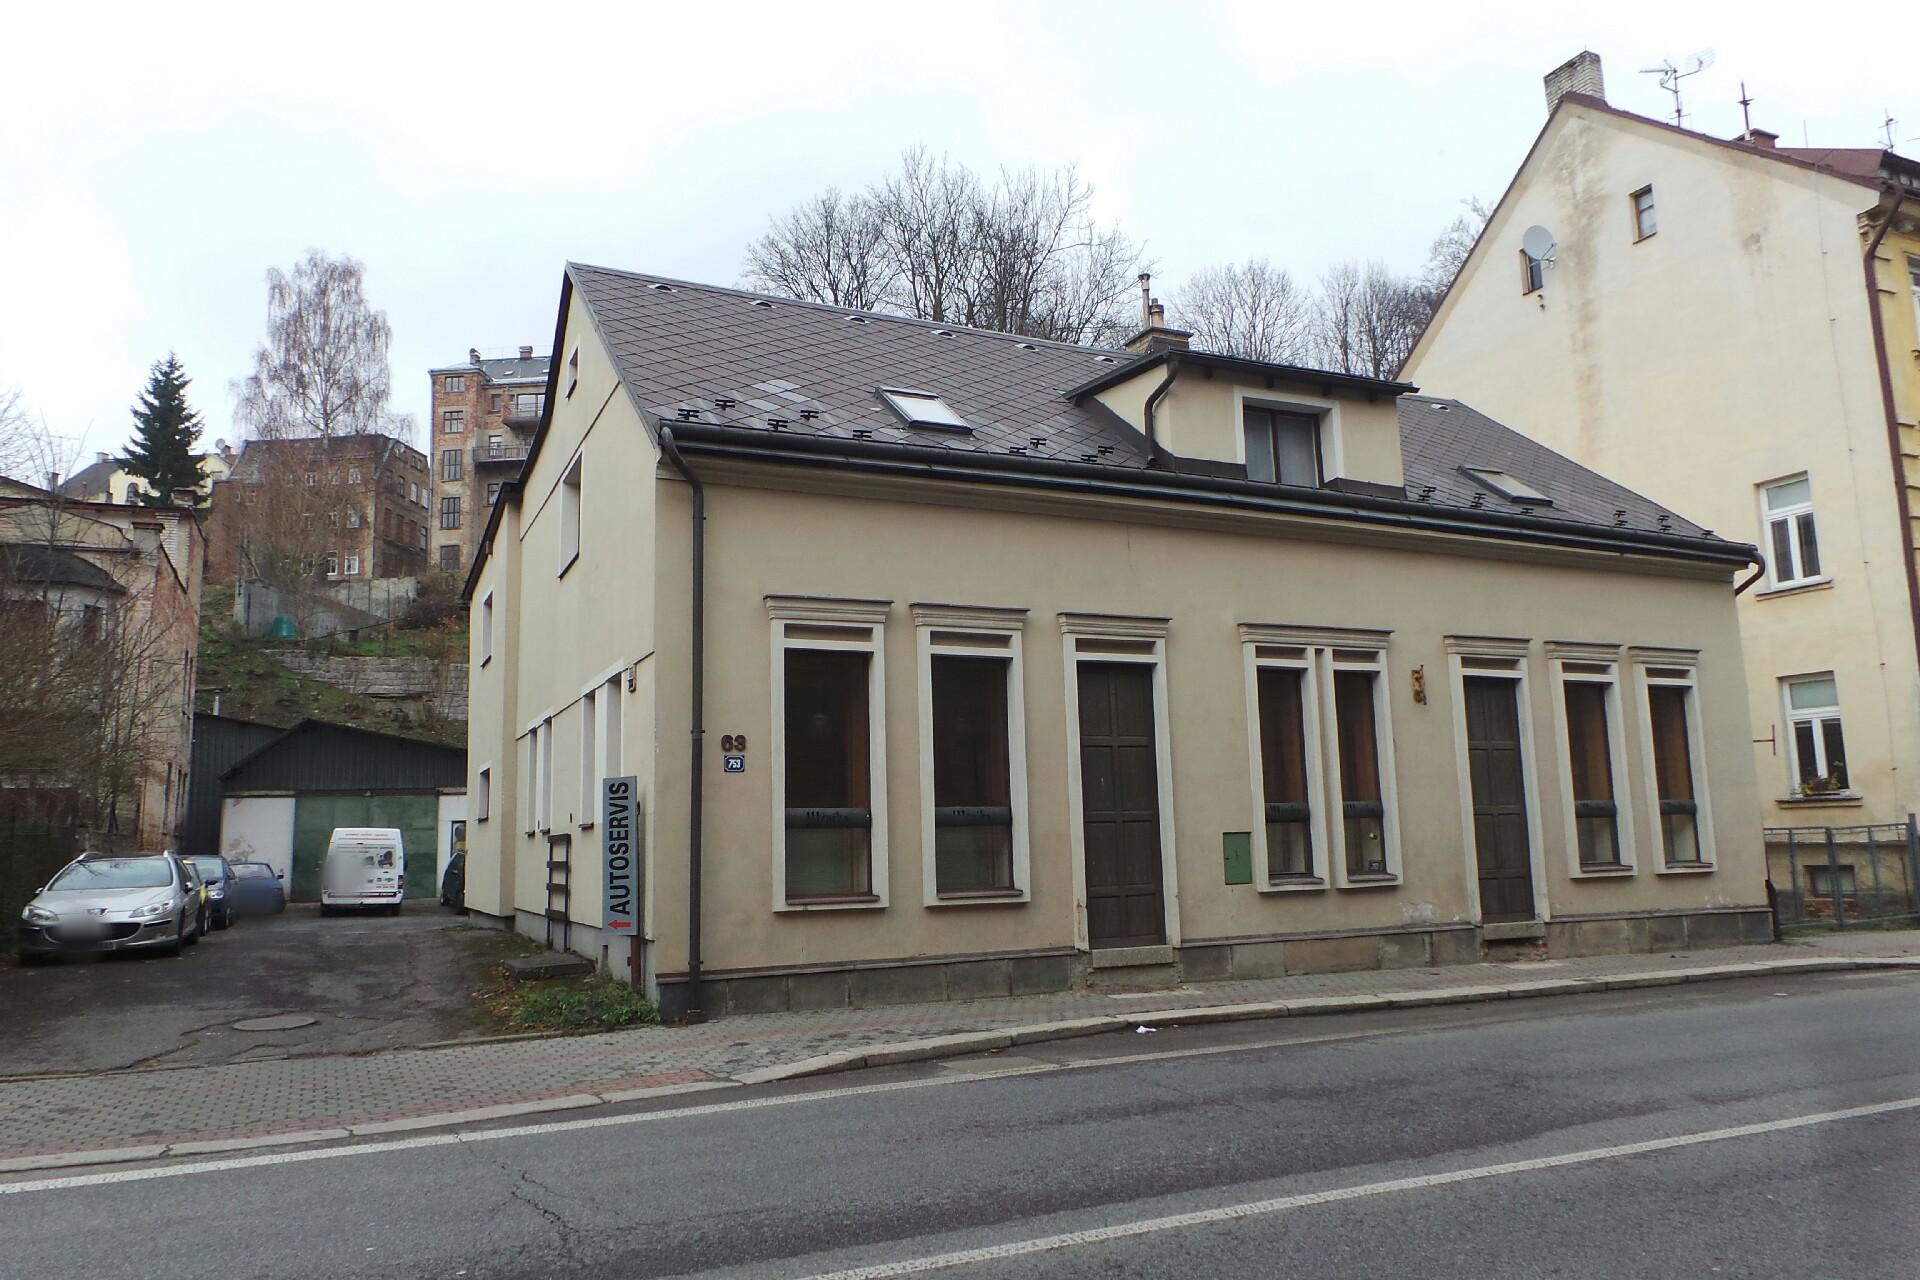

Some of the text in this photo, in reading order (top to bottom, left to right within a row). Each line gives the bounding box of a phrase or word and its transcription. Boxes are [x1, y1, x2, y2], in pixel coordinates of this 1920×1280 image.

[721, 734, 746, 752] 63
[728, 759, 741, 769] 753
[608, 781, 631, 915] AUTOSERVIS
